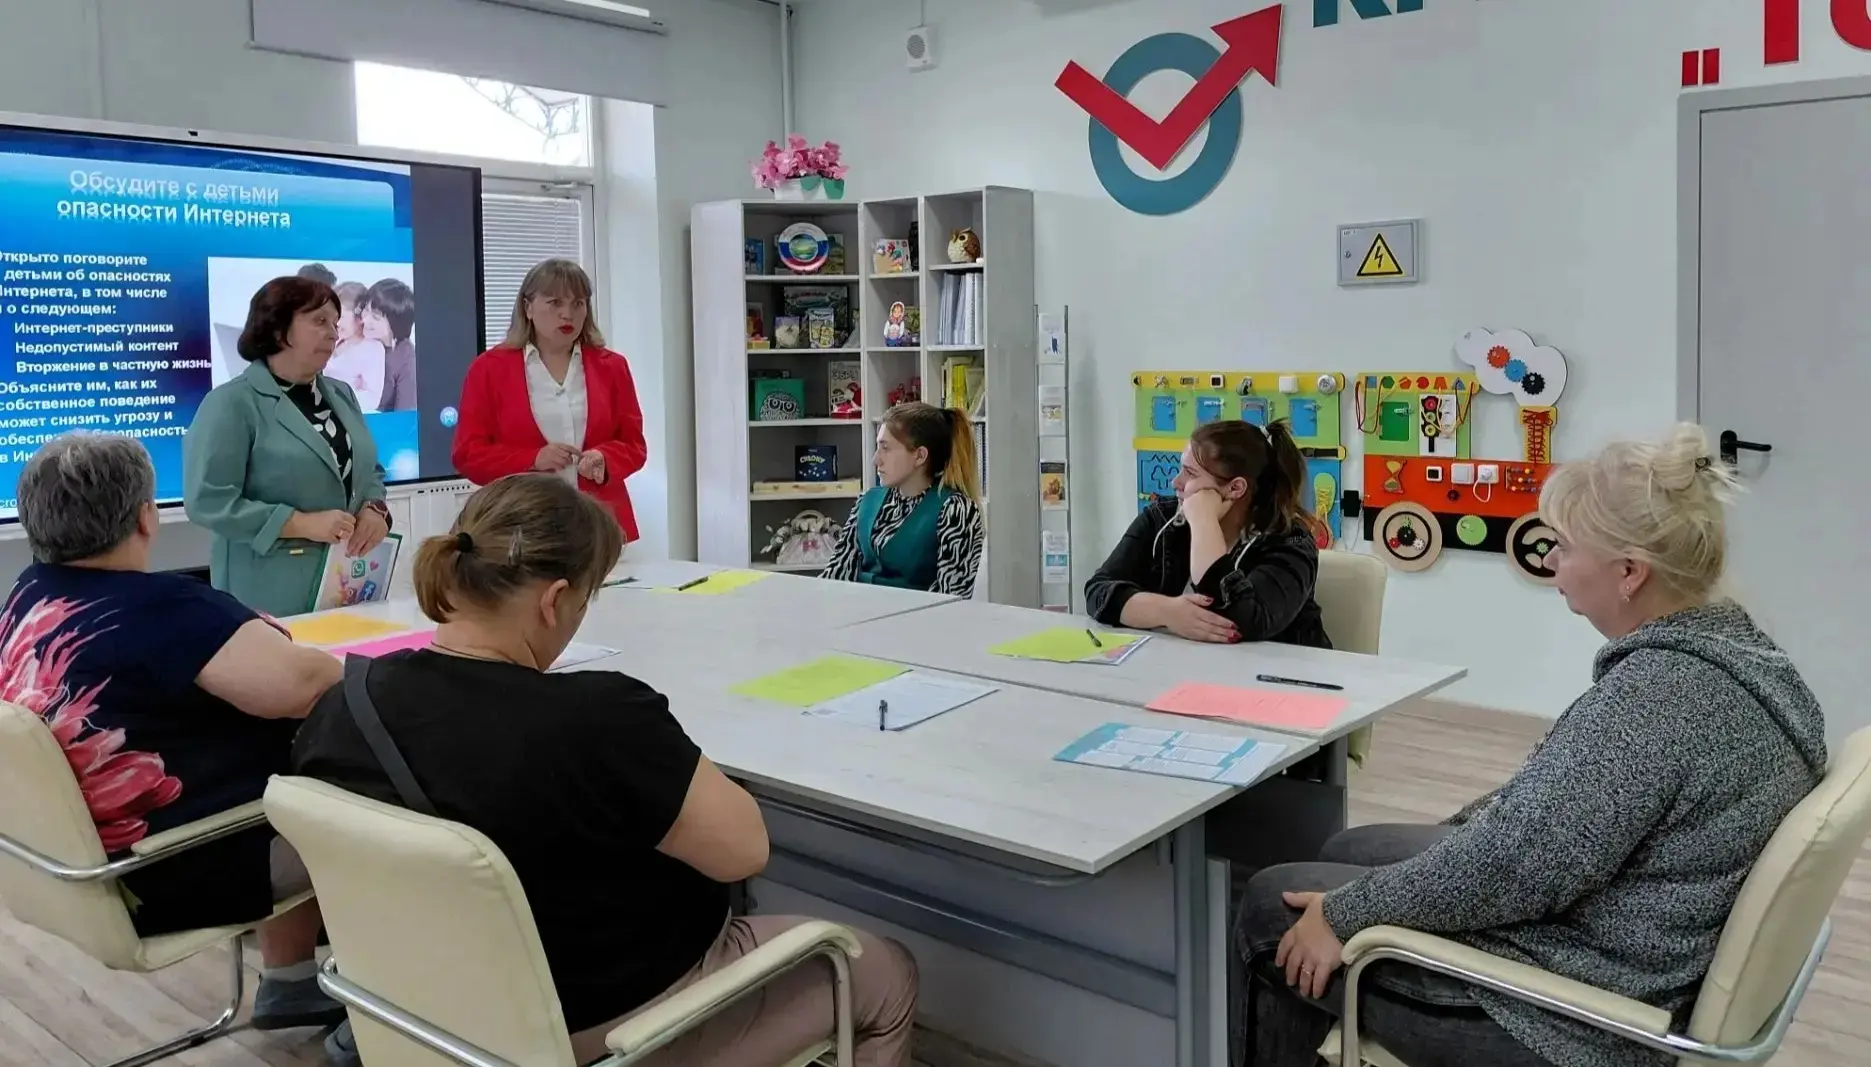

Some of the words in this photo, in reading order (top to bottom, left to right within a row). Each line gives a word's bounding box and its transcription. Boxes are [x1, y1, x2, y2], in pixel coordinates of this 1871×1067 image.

[70, 170, 180, 196] Обсудите
[186, 182, 198, 196] с
[203, 183, 280, 204] детьми
[57, 200, 178, 219] опасности
[184, 203, 291, 227] Интернета
[0, 250, 59, 265] ткрыто
[63, 253, 148, 267] поговорите
[4, 269, 62, 282] детьми
[66, 269, 85, 281] об
[89, 271, 171, 282] опасностях
[0, 284, 77, 299] нтернета,
[82, 288, 91, 298] в
[95, 288, 122, 298] том
[126, 288, 168, 298] числе
[7, 304, 17, 314] о
[21, 303, 117, 317] следующем:
[14, 322, 174, 336] Интернет-преступники
[15, 340, 124, 355] Недопустимый
[128, 341, 179, 351] контент
[16, 360, 96, 375] Вторжение
[99, 361, 109, 371] в
[112, 359, 169, 372] частную
[172, 358, 211, 370] жизнь
[87, 382, 111, 392] им,
[114, 381, 137, 391] как
[141, 379, 157, 389] их
[100, 394, 176, 407] поведение
[0, 416, 46, 428] может
[50, 414, 110, 427] снизить
[114, 411, 160, 425] угрозу
[164, 411, 173, 421] и
